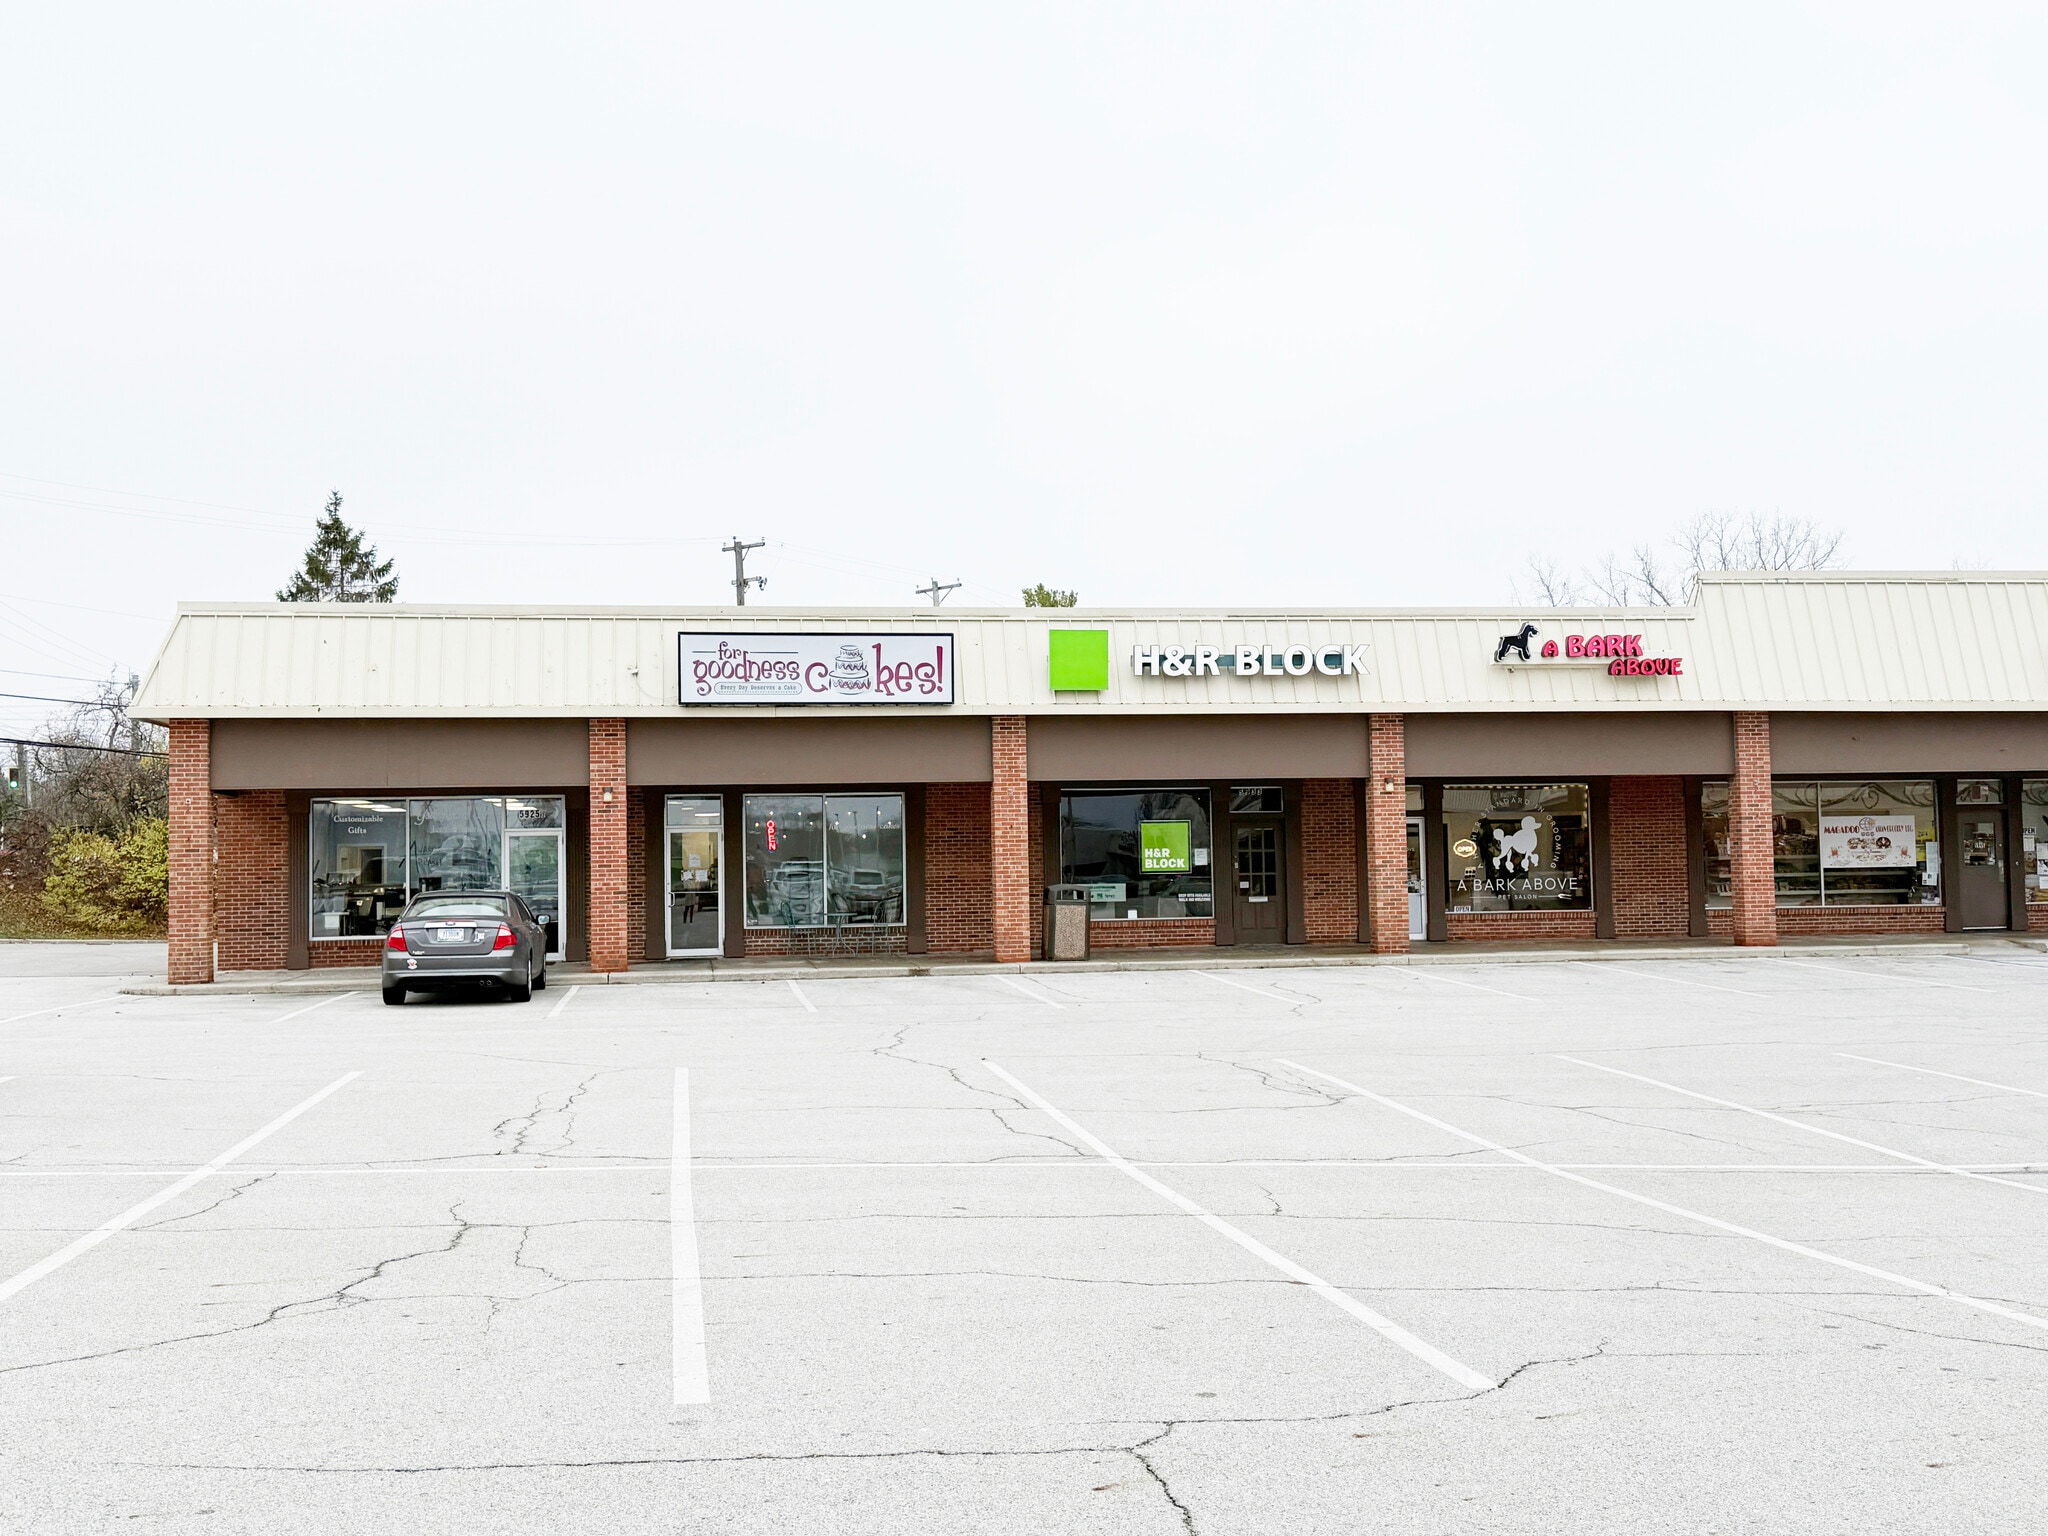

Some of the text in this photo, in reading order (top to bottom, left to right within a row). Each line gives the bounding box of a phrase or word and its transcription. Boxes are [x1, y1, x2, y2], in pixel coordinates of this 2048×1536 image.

[718, 641, 741, 660] for
[1541, 634, 1643, 658] A BARK
[804, 642, 943, 697] ckes!
[1132, 644, 1370, 677] H&R BLOCK
[1608, 657, 1683, 676] ABOVE
[693, 651, 800, 696] goodness
[720, 684, 736, 692] Every
[739, 684, 748, 692] Day
[333, 815, 384, 823] Customizable
[519, 810, 540, 819] 5925
[347, 826, 367, 834] Gifts
[766, 820, 777, 851] OPEN
[1546, 814, 1562, 869] GROOMING
[1144, 848, 1171, 858] H&R
[1145, 858, 1186, 869] BLOCK
[1457, 877, 1578, 892] A BARK ABOVE
